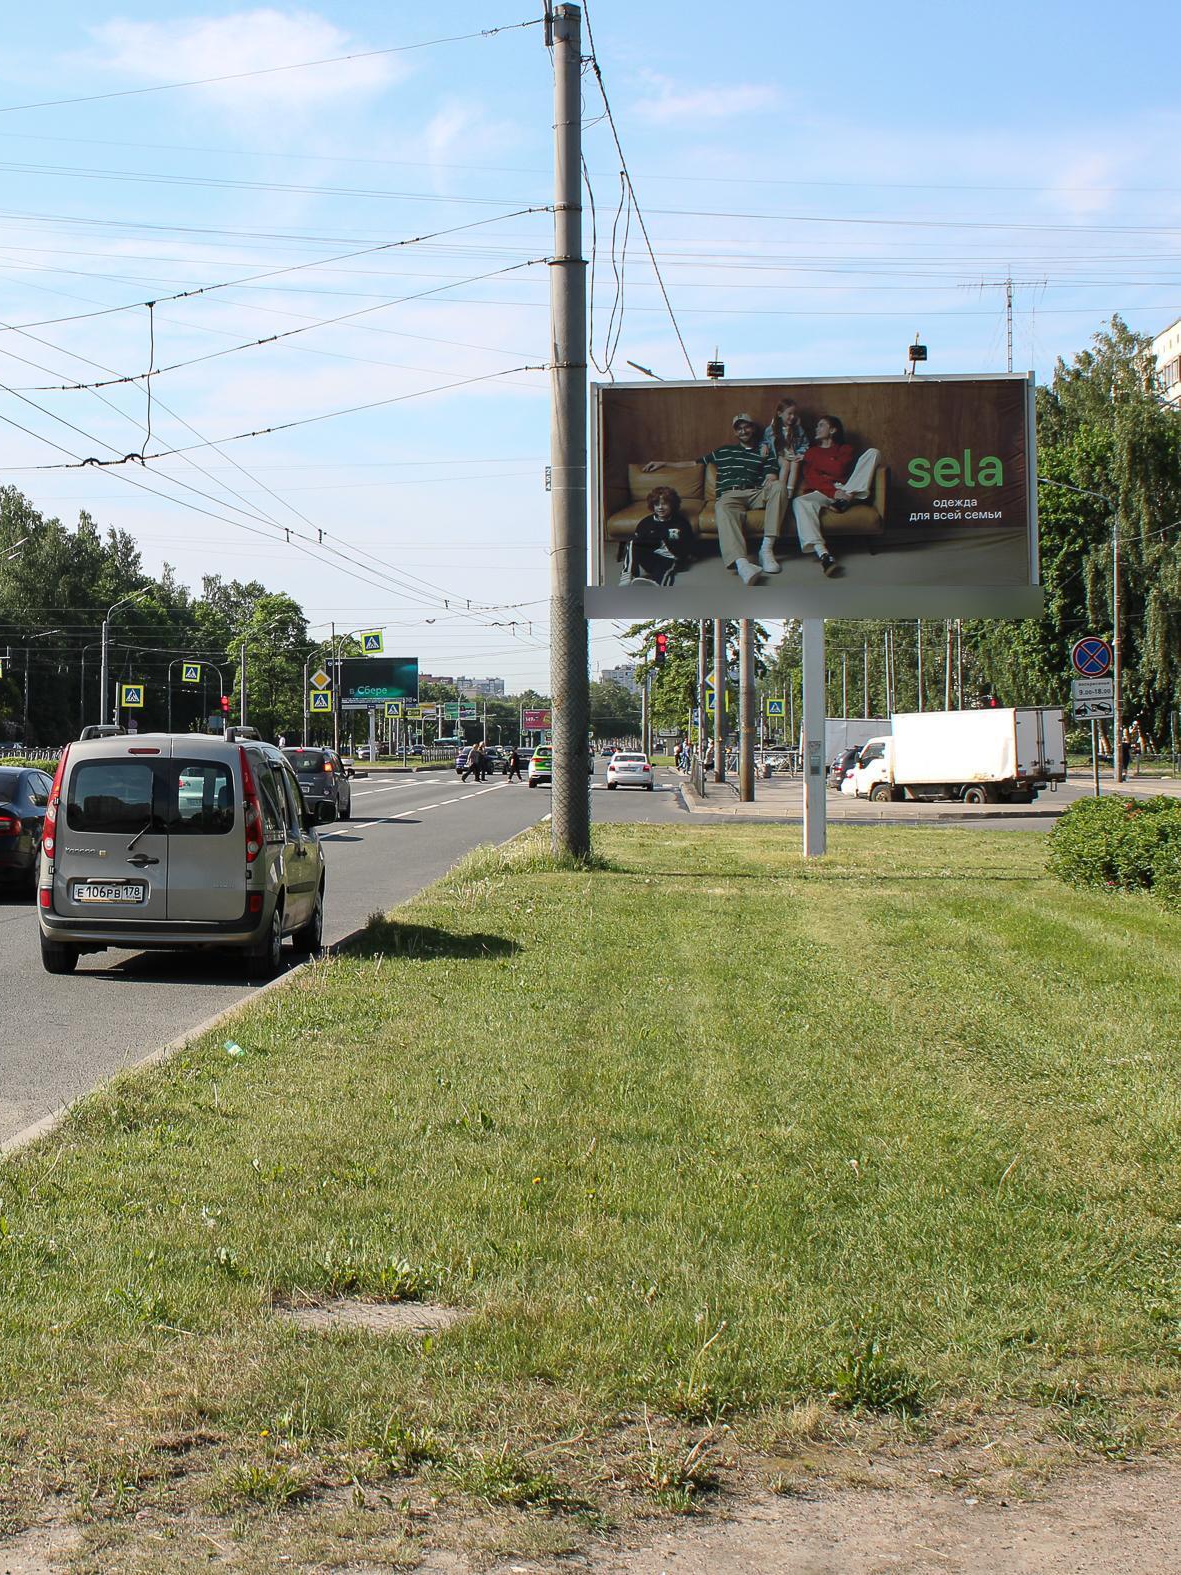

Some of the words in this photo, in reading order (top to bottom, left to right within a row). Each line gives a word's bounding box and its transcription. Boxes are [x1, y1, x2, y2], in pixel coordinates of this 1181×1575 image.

[907, 448, 1003, 489] sela
[932, 499, 978, 508] одежда
[909, 512, 931, 521] для
[933, 510, 962, 520] всей
[964, 511, 1002, 519] семьи
[123, 886, 140, 896] 178
